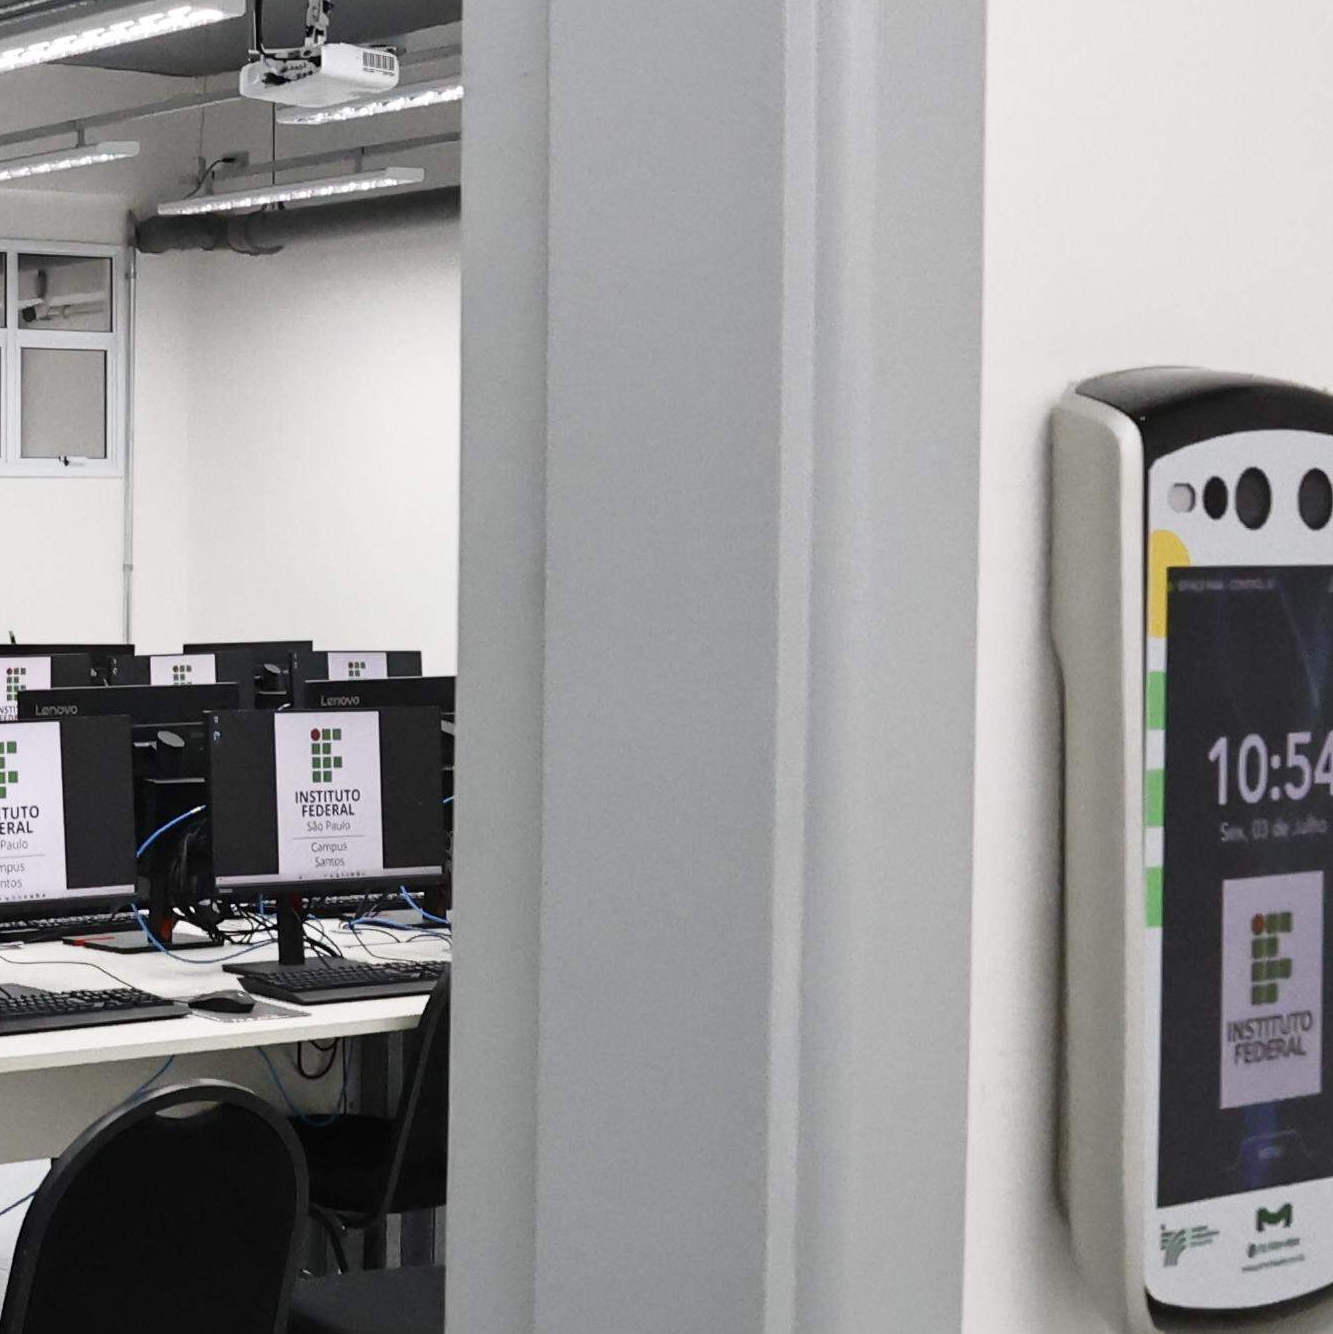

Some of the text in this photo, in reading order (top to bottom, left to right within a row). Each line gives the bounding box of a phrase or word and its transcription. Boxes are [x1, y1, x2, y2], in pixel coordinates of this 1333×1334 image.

[321, 695, 360, 707] Lenovo
[35, 704, 78, 716] Lenovo
[1208, 730, 1333, 806] 10:54
[295, 789, 361, 804] INSTITUTO
[301, 803, 355, 818] FEDERAL
[0, 839, 29, 851] Paulo
[310, 841, 348, 853] Campus
[1227, 1010, 1313, 1042] INSTITUTO
[1235, 1037, 1307, 1065] FEDERAL
